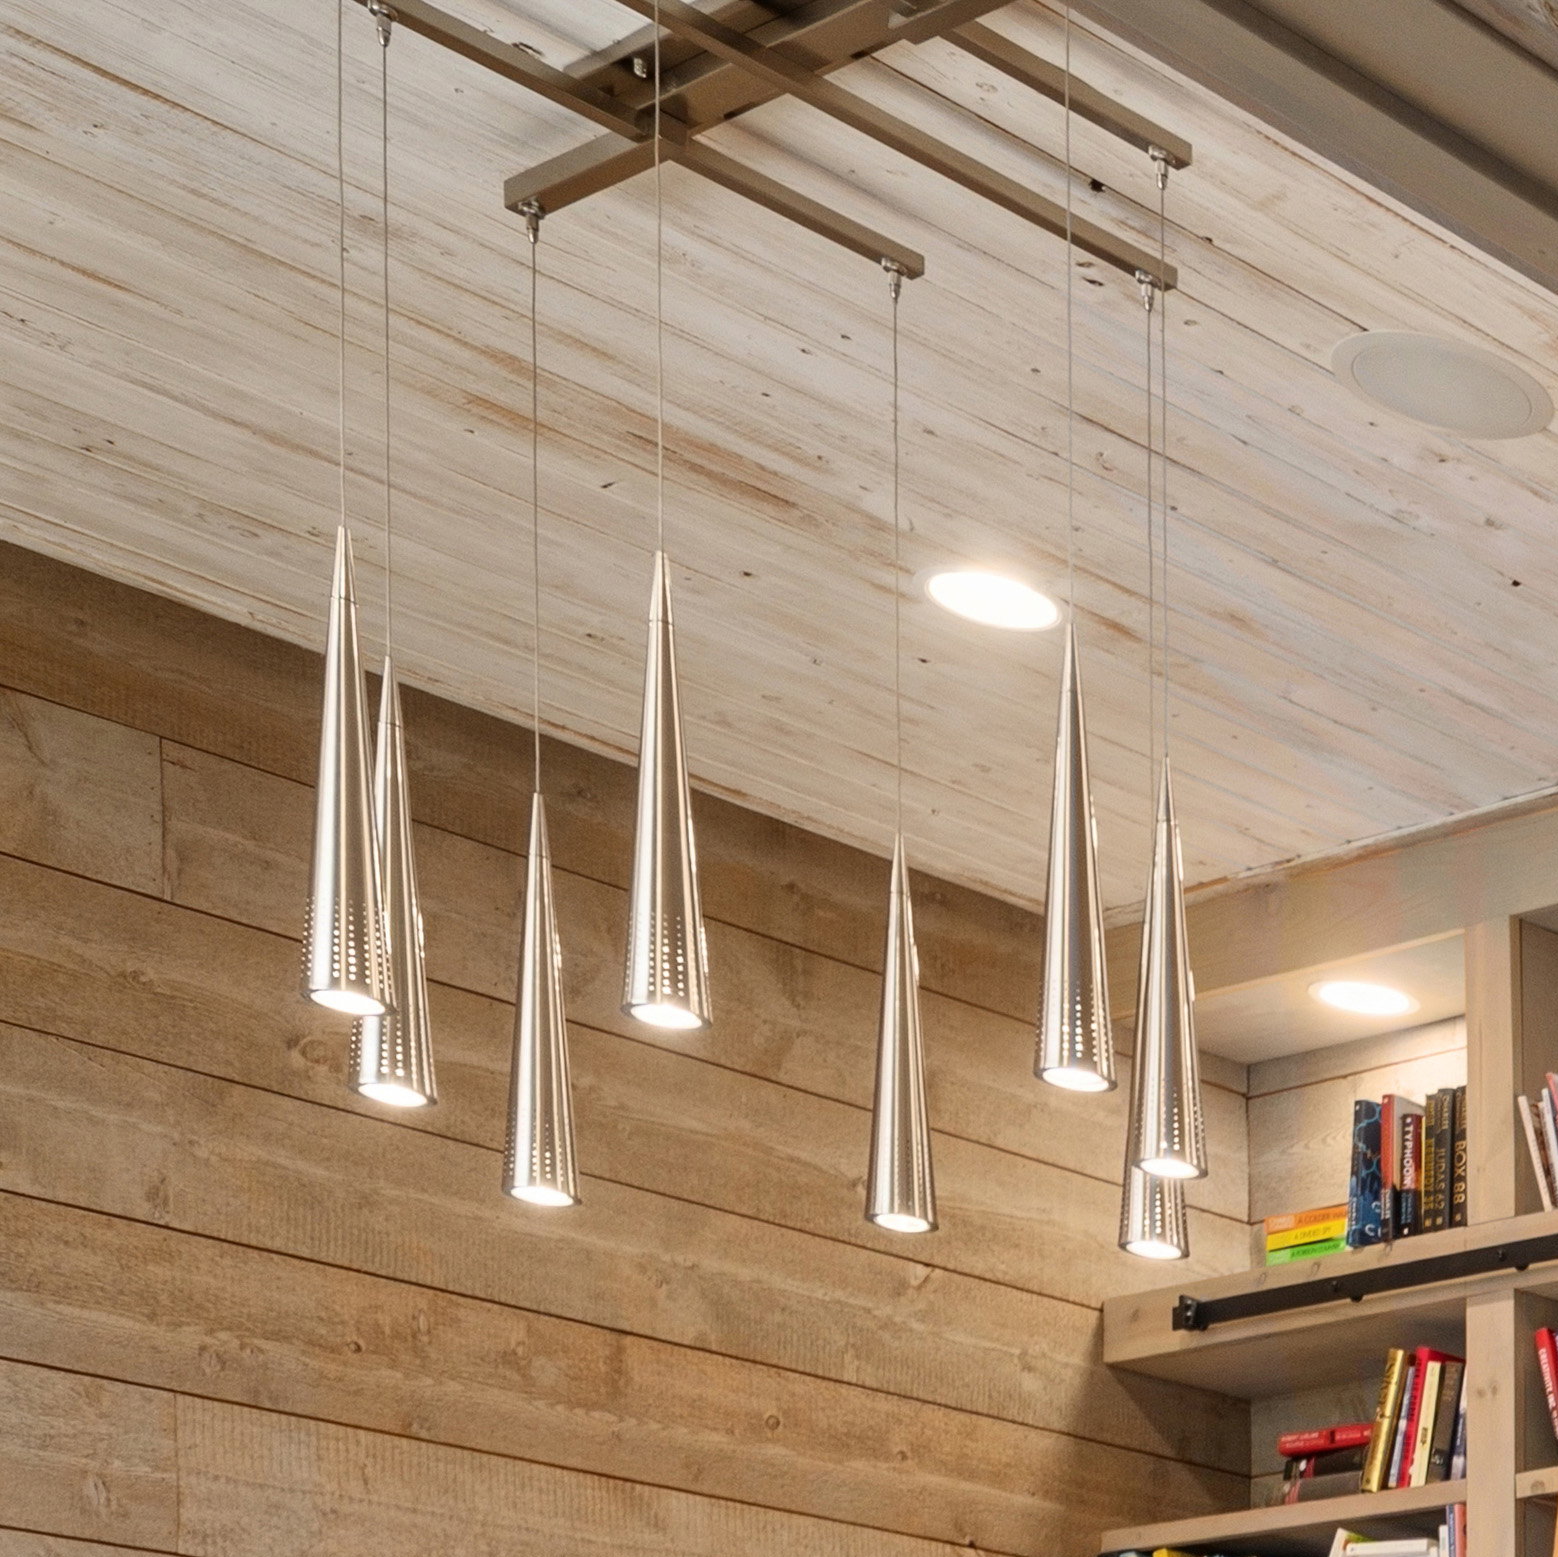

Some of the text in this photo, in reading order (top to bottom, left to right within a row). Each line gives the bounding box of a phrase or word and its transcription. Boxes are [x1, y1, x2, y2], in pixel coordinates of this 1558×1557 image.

[1403, 1124, 1416, 1188] TYPHOON
[1453, 1140, 1467, 1204] BOX 88
